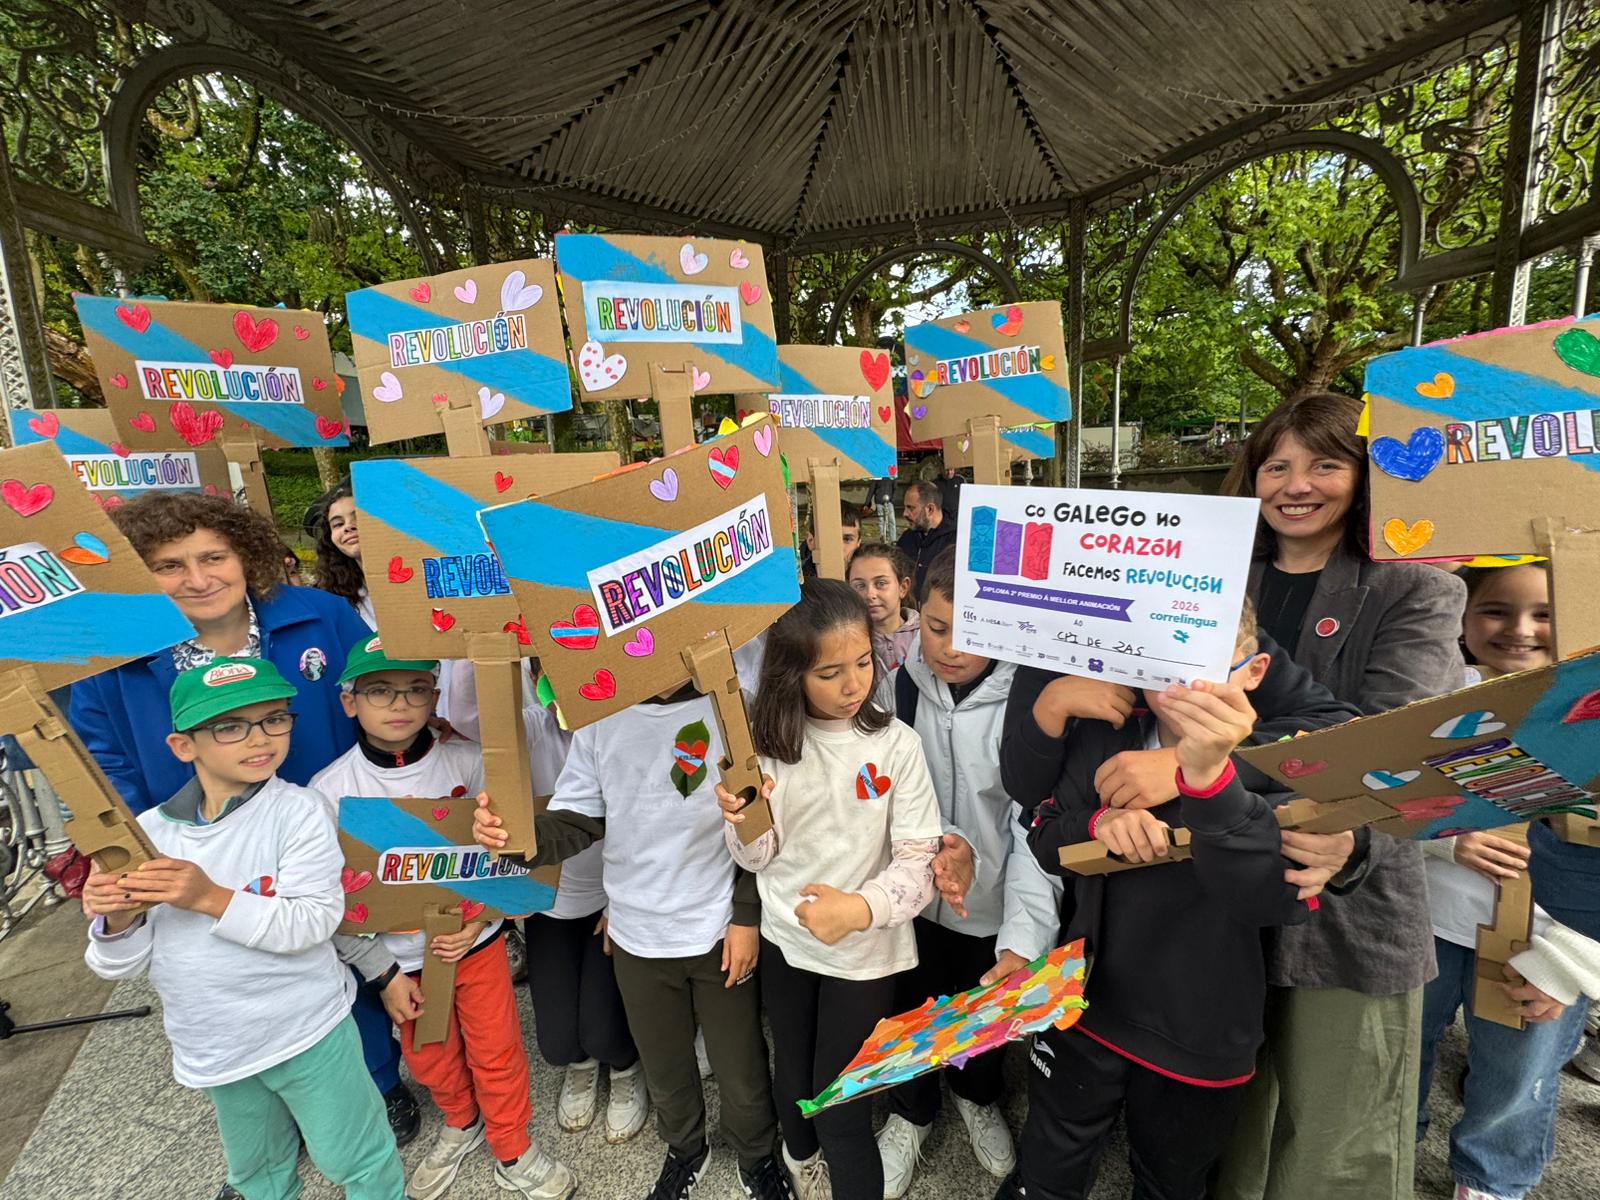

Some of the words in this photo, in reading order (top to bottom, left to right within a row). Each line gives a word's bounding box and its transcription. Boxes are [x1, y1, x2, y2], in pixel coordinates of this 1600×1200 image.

[597, 294, 732, 333] REVOLUCIÓN
[390, 311, 526, 368] REVOLUCIÓN
[937, 345, 1041, 385] REVOLUCIÓN
[142, 366, 301, 403] REVOLUCIÓN
[1445, 408, 1600, 465] REVOL
[1080, 533, 1182, 559] CORAZÓN
[598, 508, 770, 630] REVOLUCIÓN
[982, 586, 1010, 596] DIPLOMA
[1017, 591, 1043, 601] PREMIO
[1049, 596, 1078, 606] MELLOR
[1079, 600, 1121, 612] ANIMACIÓN
[1172, 600, 1200, 612] 2026
[1150, 612, 1218, 628] correlingua
[1057, 631, 1078, 644] CPI
[1087, 637, 1102, 648] DE
